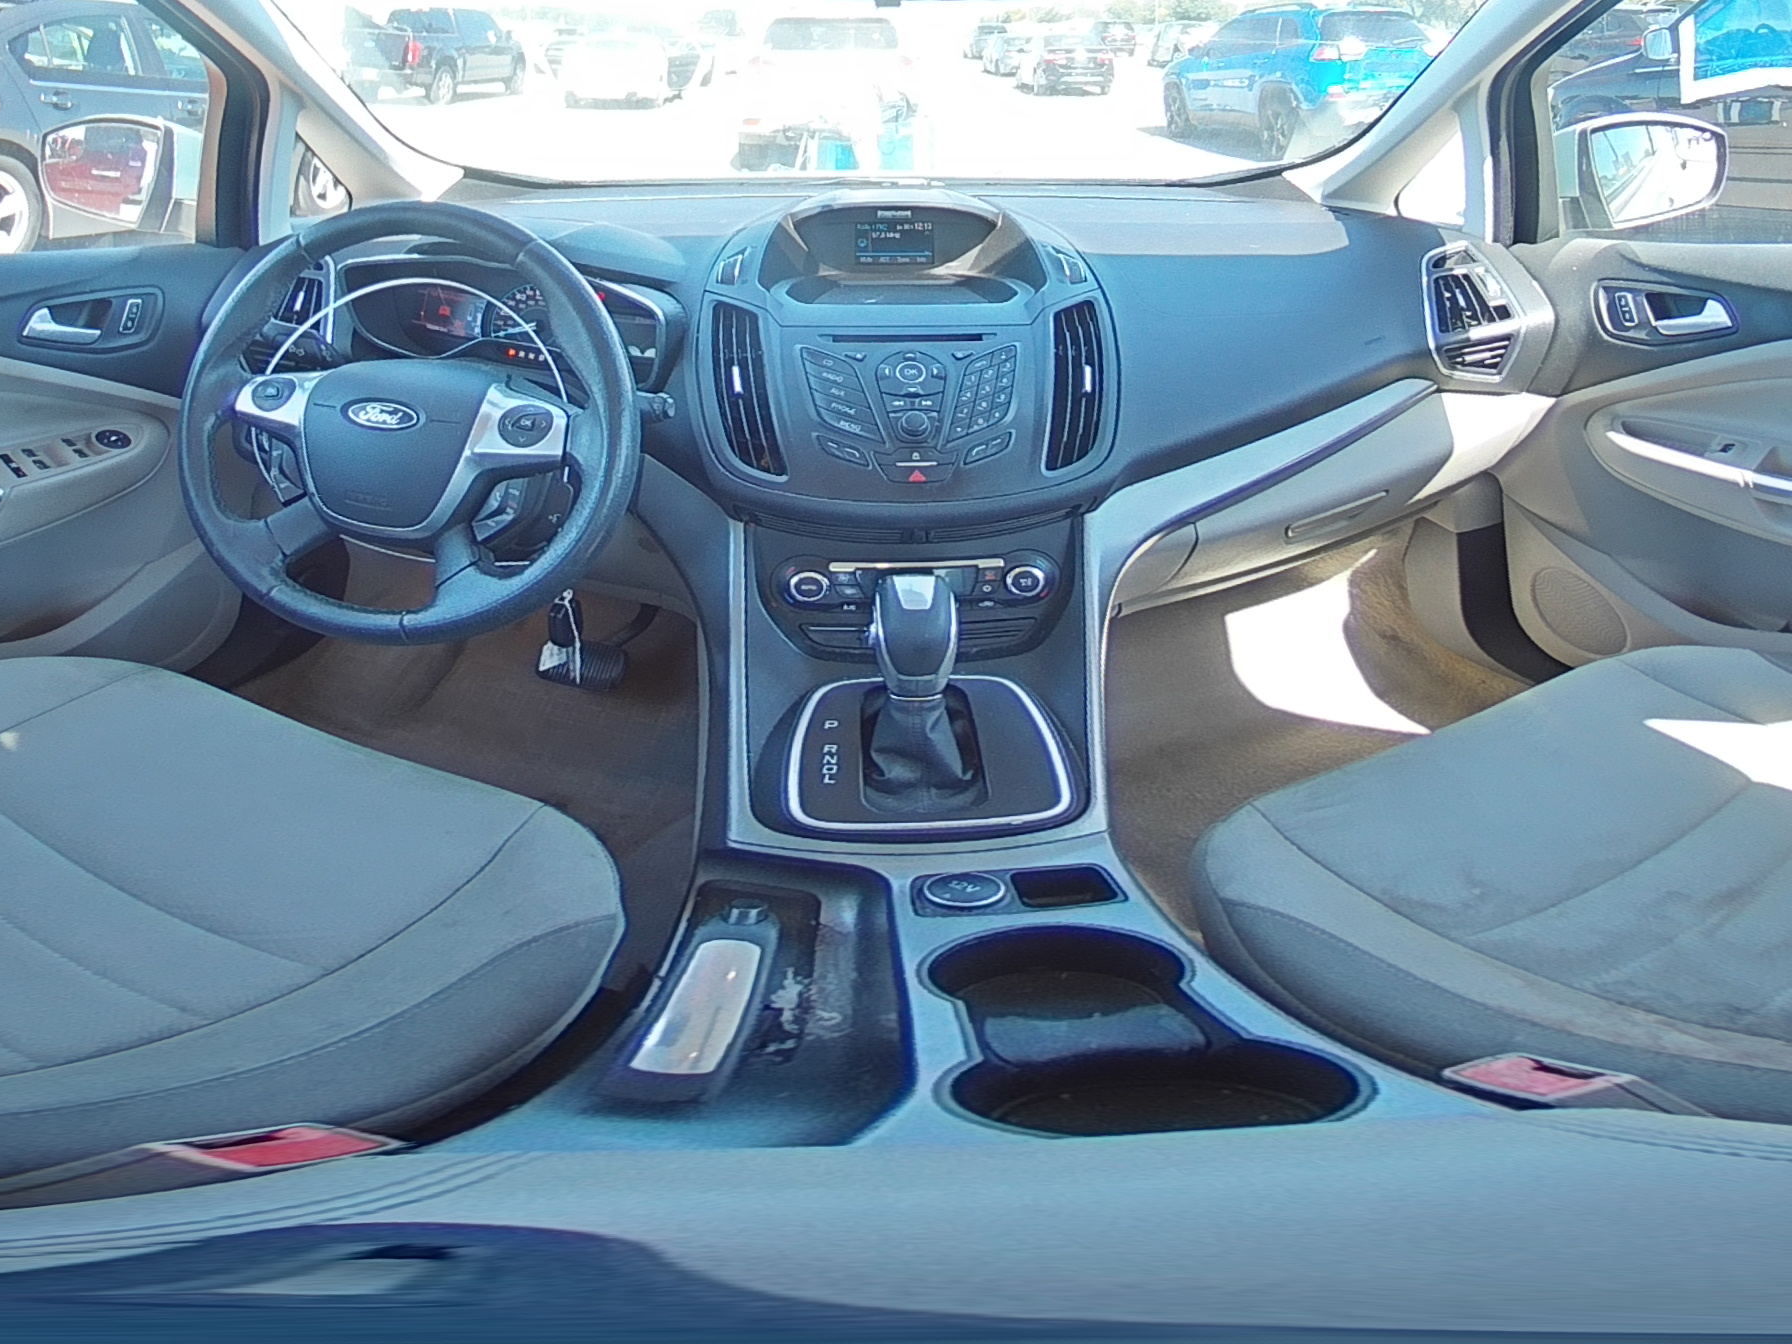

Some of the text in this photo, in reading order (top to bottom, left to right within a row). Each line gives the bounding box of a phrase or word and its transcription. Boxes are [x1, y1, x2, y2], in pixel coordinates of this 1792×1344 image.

[904, 368, 919, 376] OK
[358, 403, 404, 425] Ford
[823, 719, 840, 730] P
[822, 743, 839, 754] R
[822, 754, 838, 765] N
[821, 764, 838, 775] D
[822, 774, 837, 785] L
[948, 879, 982, 893] 12V
